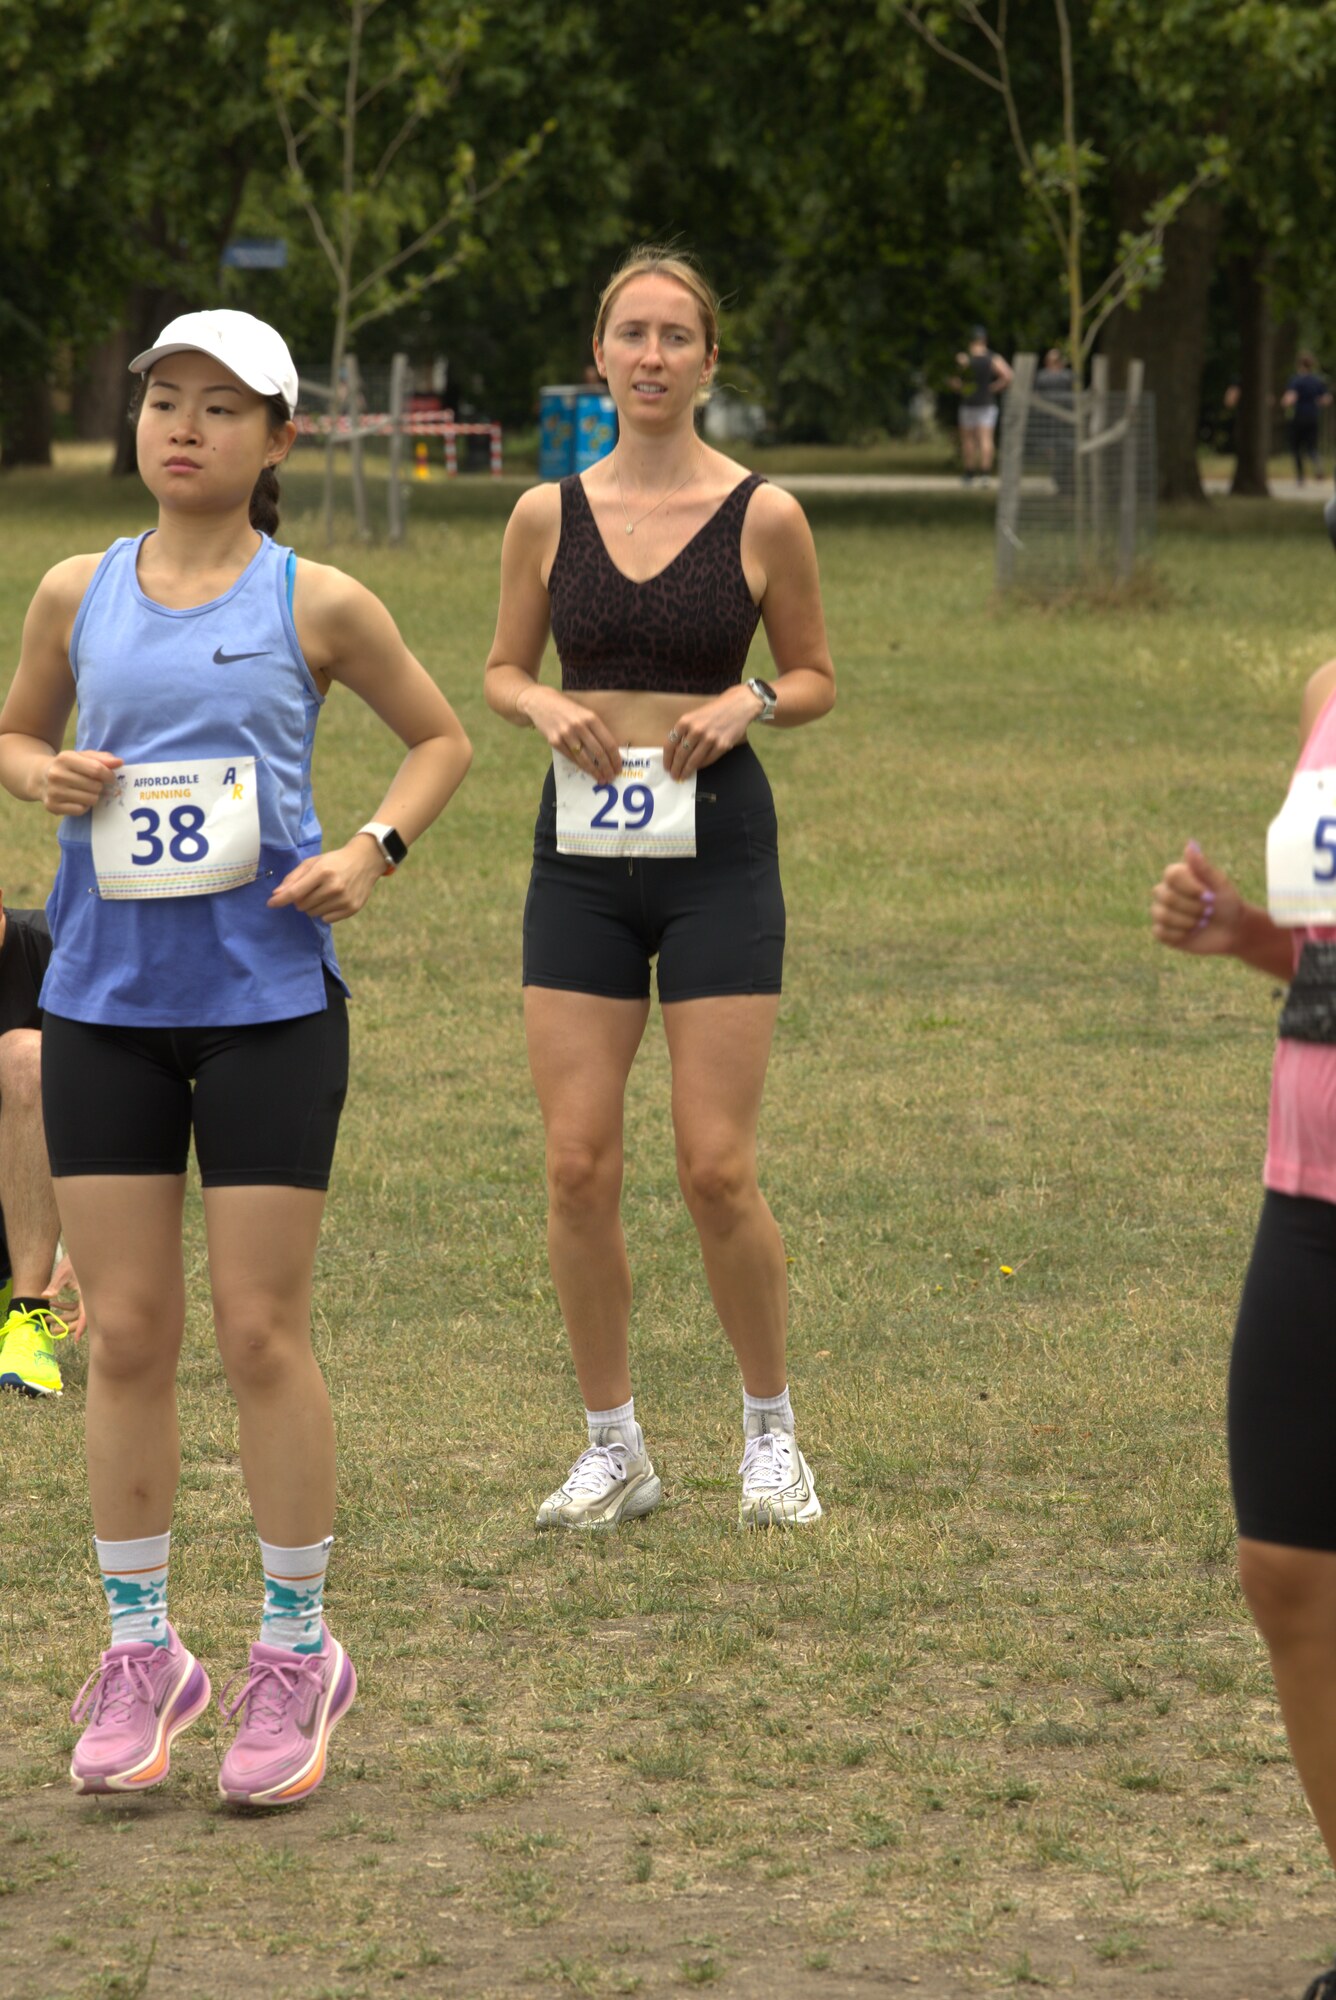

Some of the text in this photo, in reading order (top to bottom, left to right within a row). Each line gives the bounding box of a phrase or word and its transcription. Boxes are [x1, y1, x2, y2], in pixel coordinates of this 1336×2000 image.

[133, 774, 200, 788] AFFORDABLE
[139, 788, 192, 801] RUNNING
[590, 783, 655, 829] 29
[129, 804, 210, 866] 38
